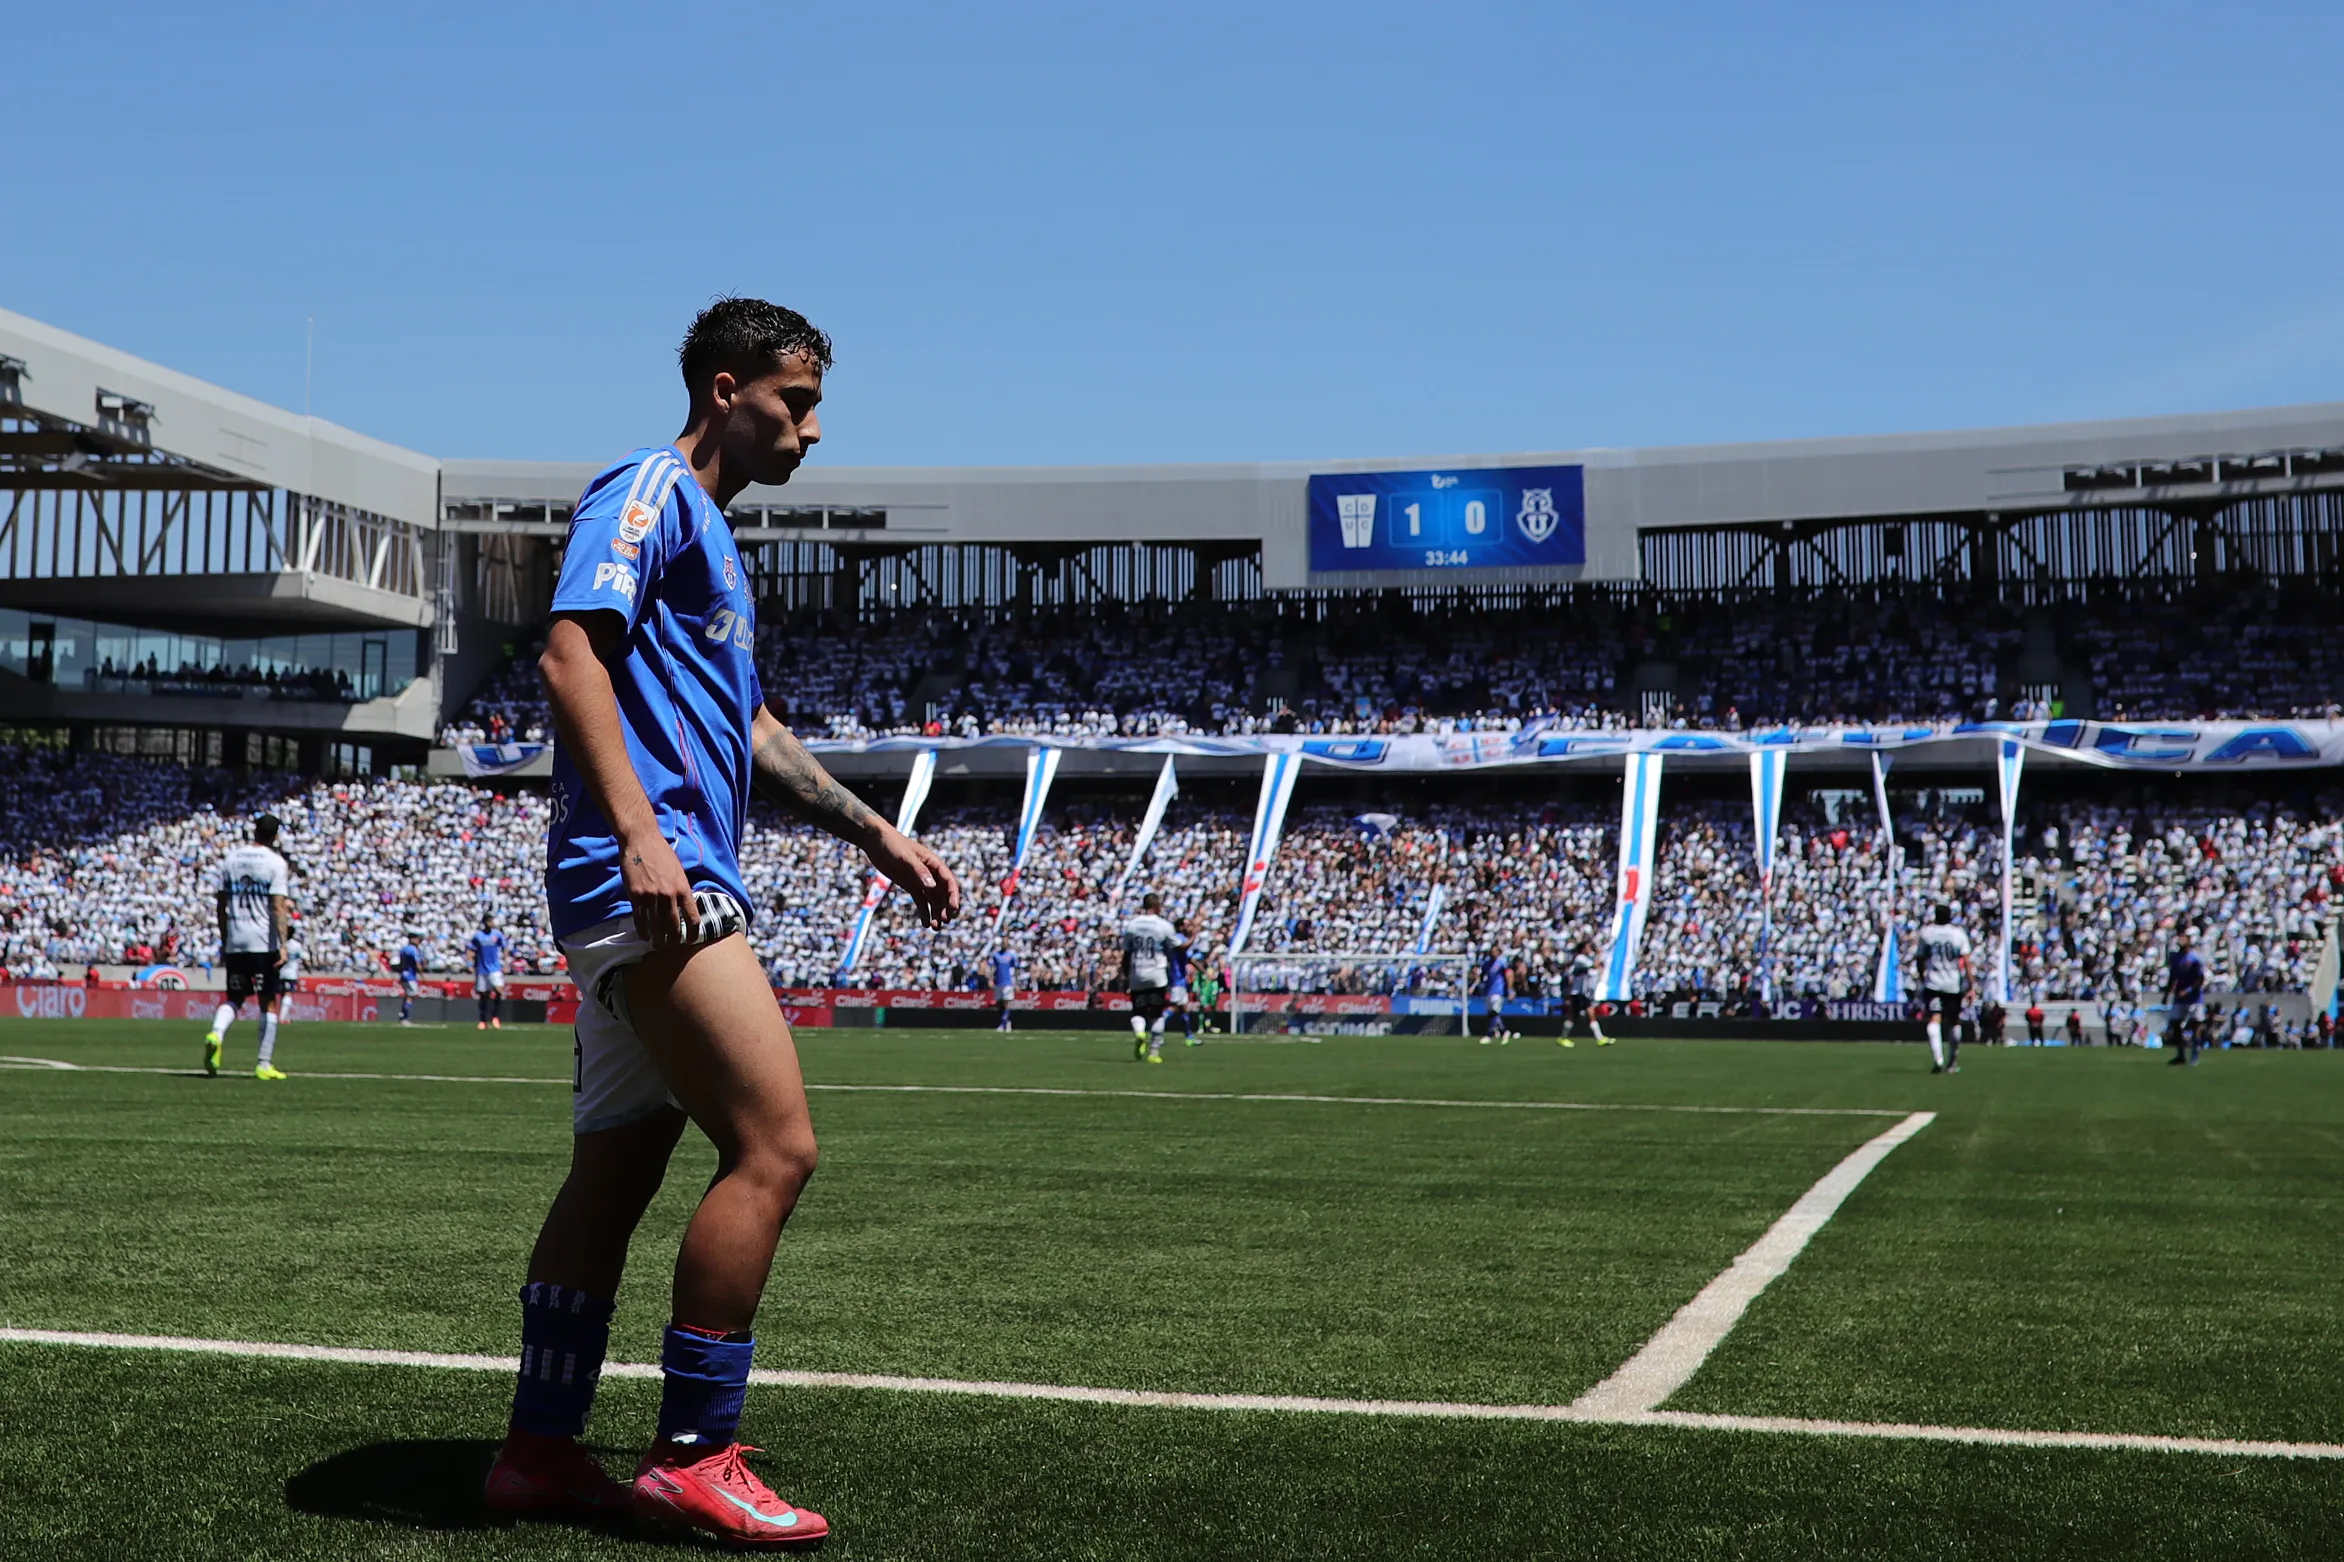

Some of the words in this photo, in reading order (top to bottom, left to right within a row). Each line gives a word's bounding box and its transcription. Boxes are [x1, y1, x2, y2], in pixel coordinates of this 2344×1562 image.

[1404, 503, 1420, 536] 1
[1465, 501, 1486, 535] 0
[1425, 551, 1468, 566] 33:44
[316, 983, 350, 996] Claro
[16, 985, 87, 1018] Claro
[835, 994, 873, 1008] Claro
[891, 995, 929, 1008] Claro
[943, 997, 982, 1009] Claro
[1337, 1001, 1379, 1014] Claro
